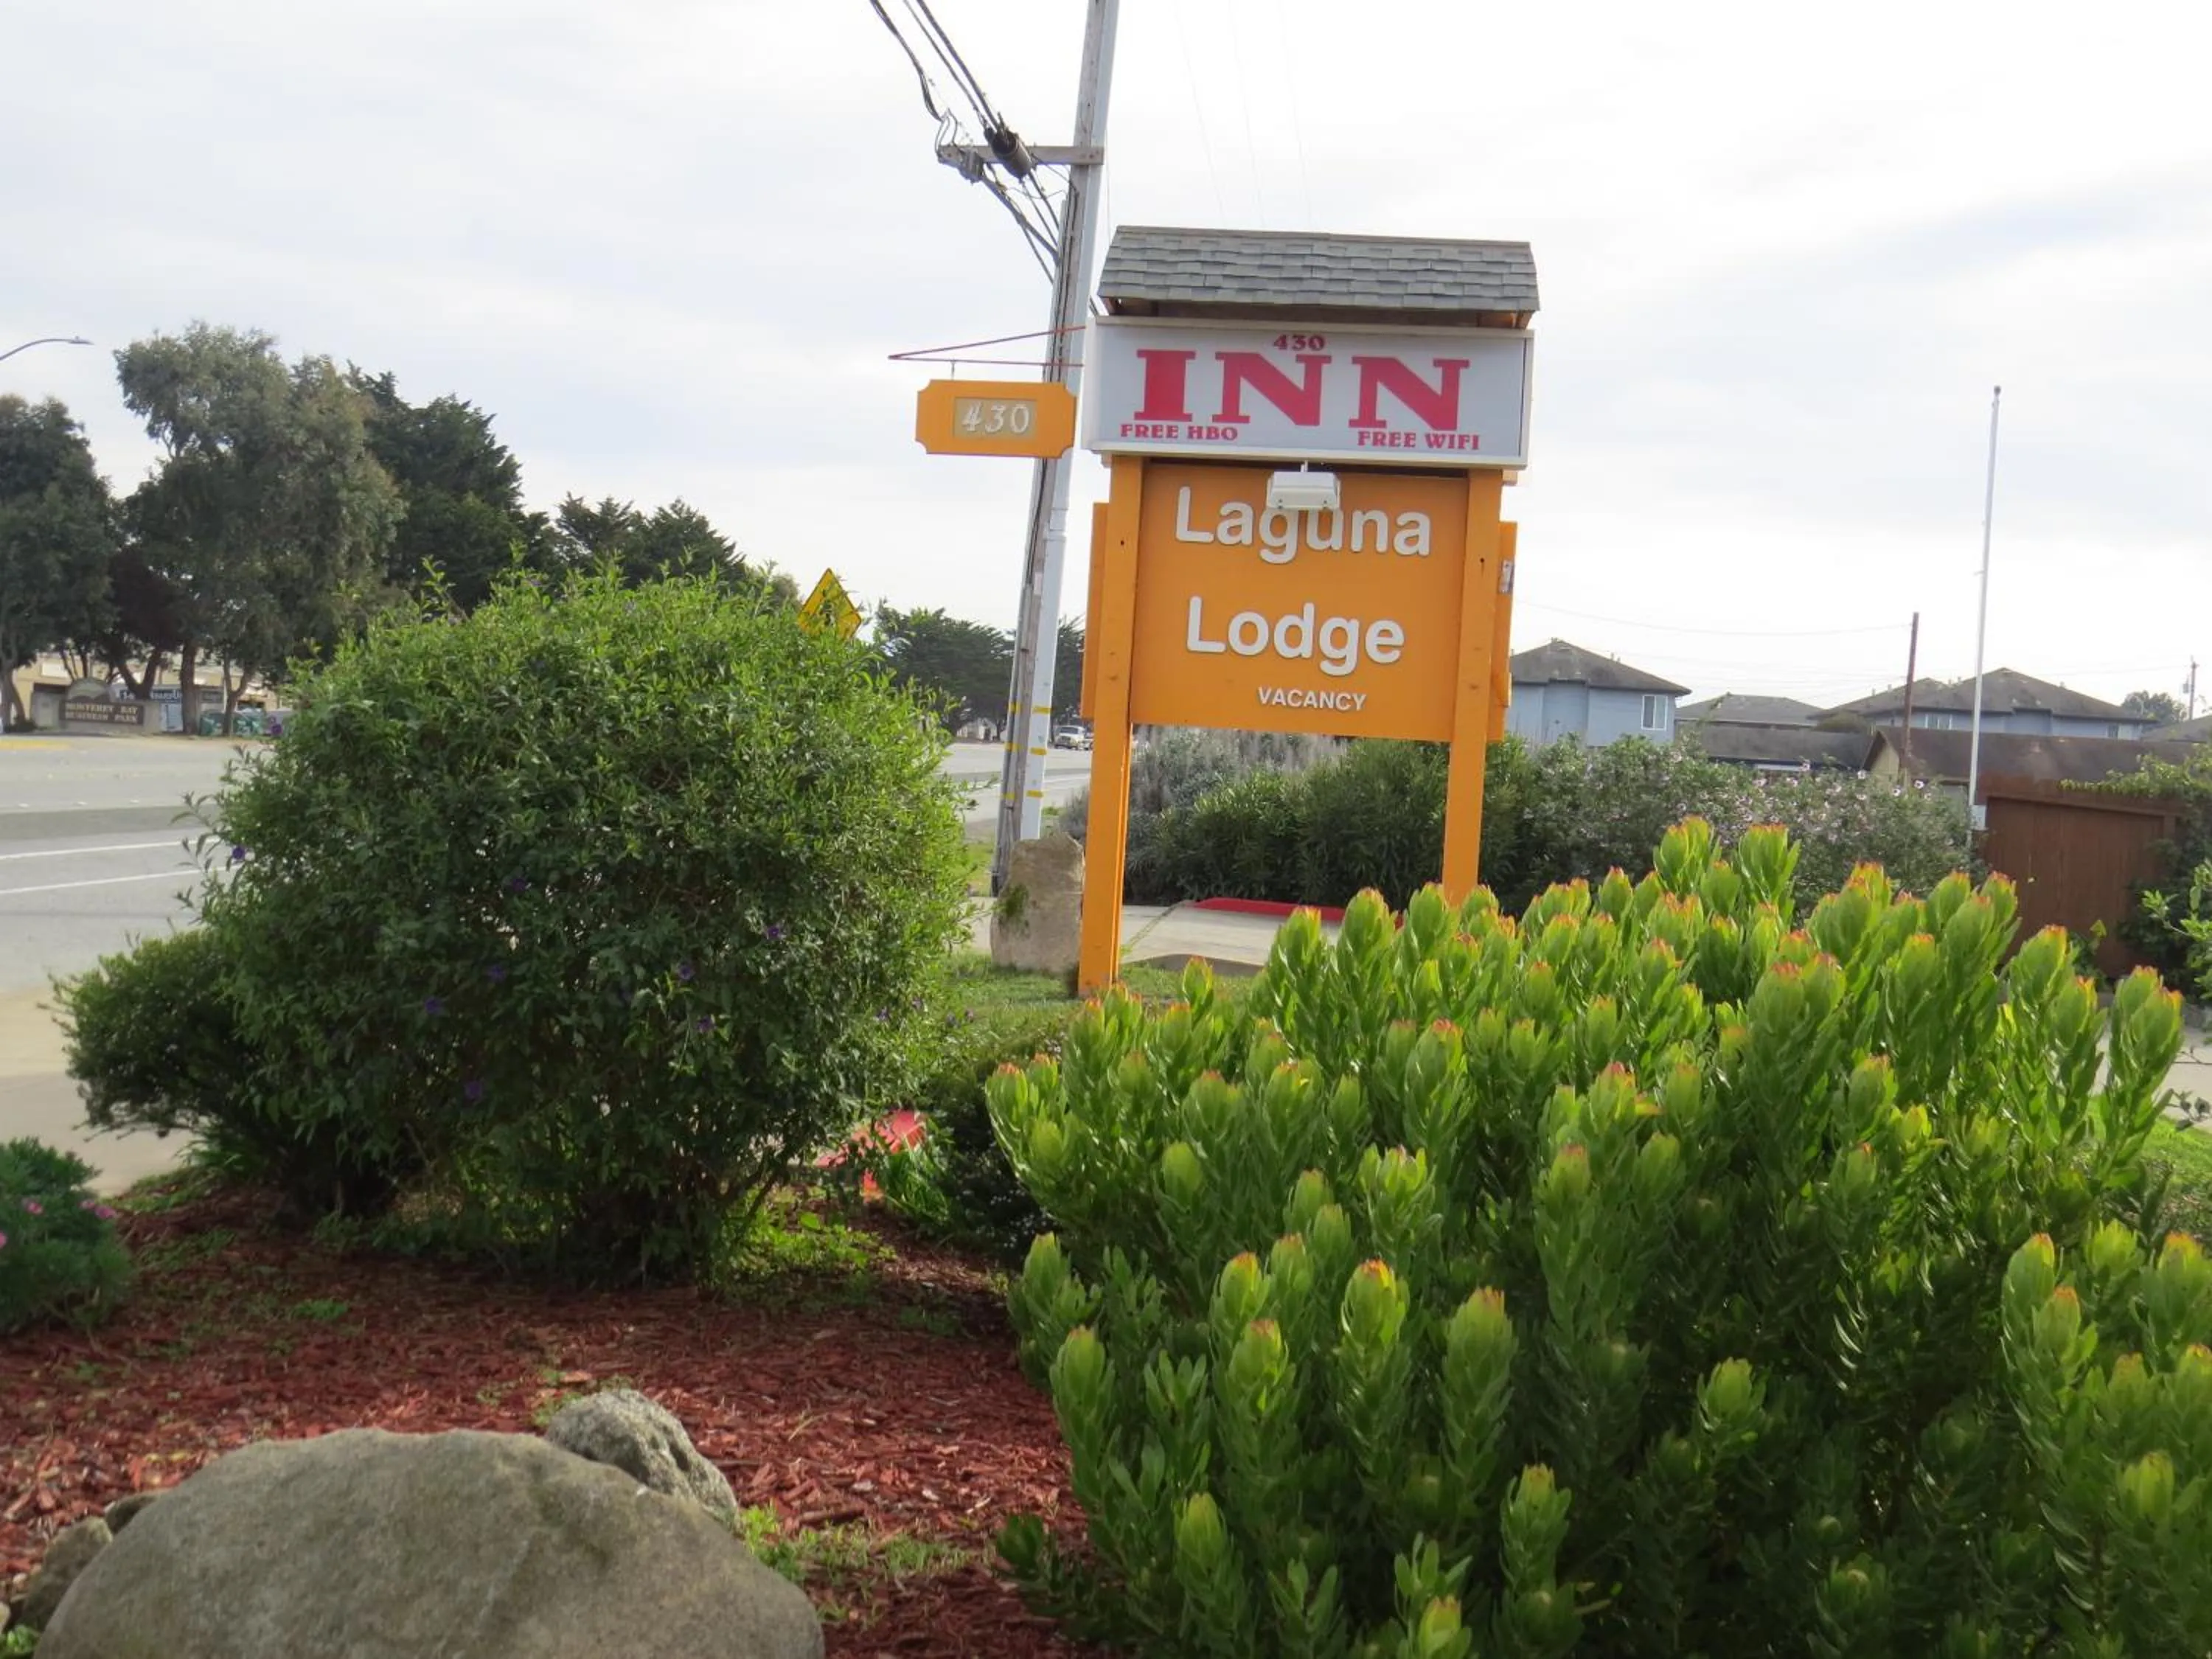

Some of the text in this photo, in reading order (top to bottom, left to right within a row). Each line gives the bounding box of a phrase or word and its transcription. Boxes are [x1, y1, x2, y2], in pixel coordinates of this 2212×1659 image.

[1273, 335, 1325, 351] 430
[1134, 349, 1470, 431] INN
[961, 402, 1030, 433] 430
[1121, 425, 1238, 441] FREE HBO
[1357, 431, 1480, 451] FREE WIFI
[1175, 486, 1431, 564] Laguna
[1187, 596, 1405, 676] Lodge
[1258, 686, 1367, 712] VACANCY
